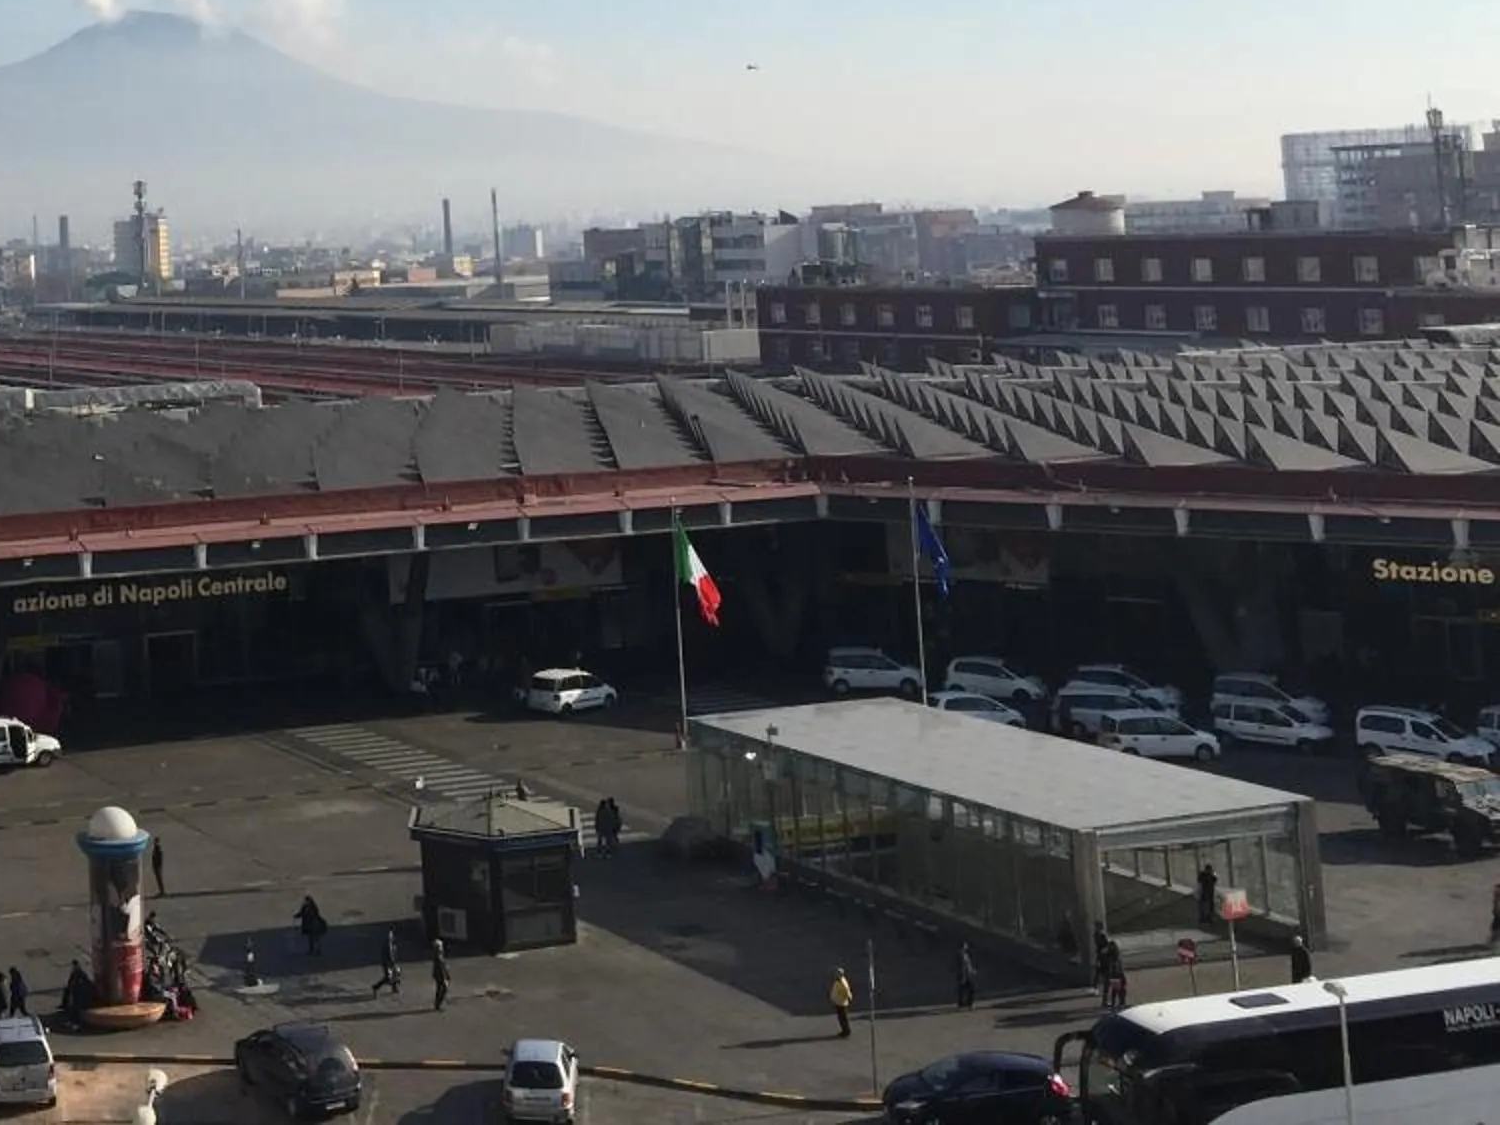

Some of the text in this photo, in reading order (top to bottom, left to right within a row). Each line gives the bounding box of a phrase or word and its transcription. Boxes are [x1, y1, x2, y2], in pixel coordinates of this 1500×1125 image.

[1371, 558, 1495, 585] Stazione
[13, 572, 287, 613] azione di Napoli Centrale
